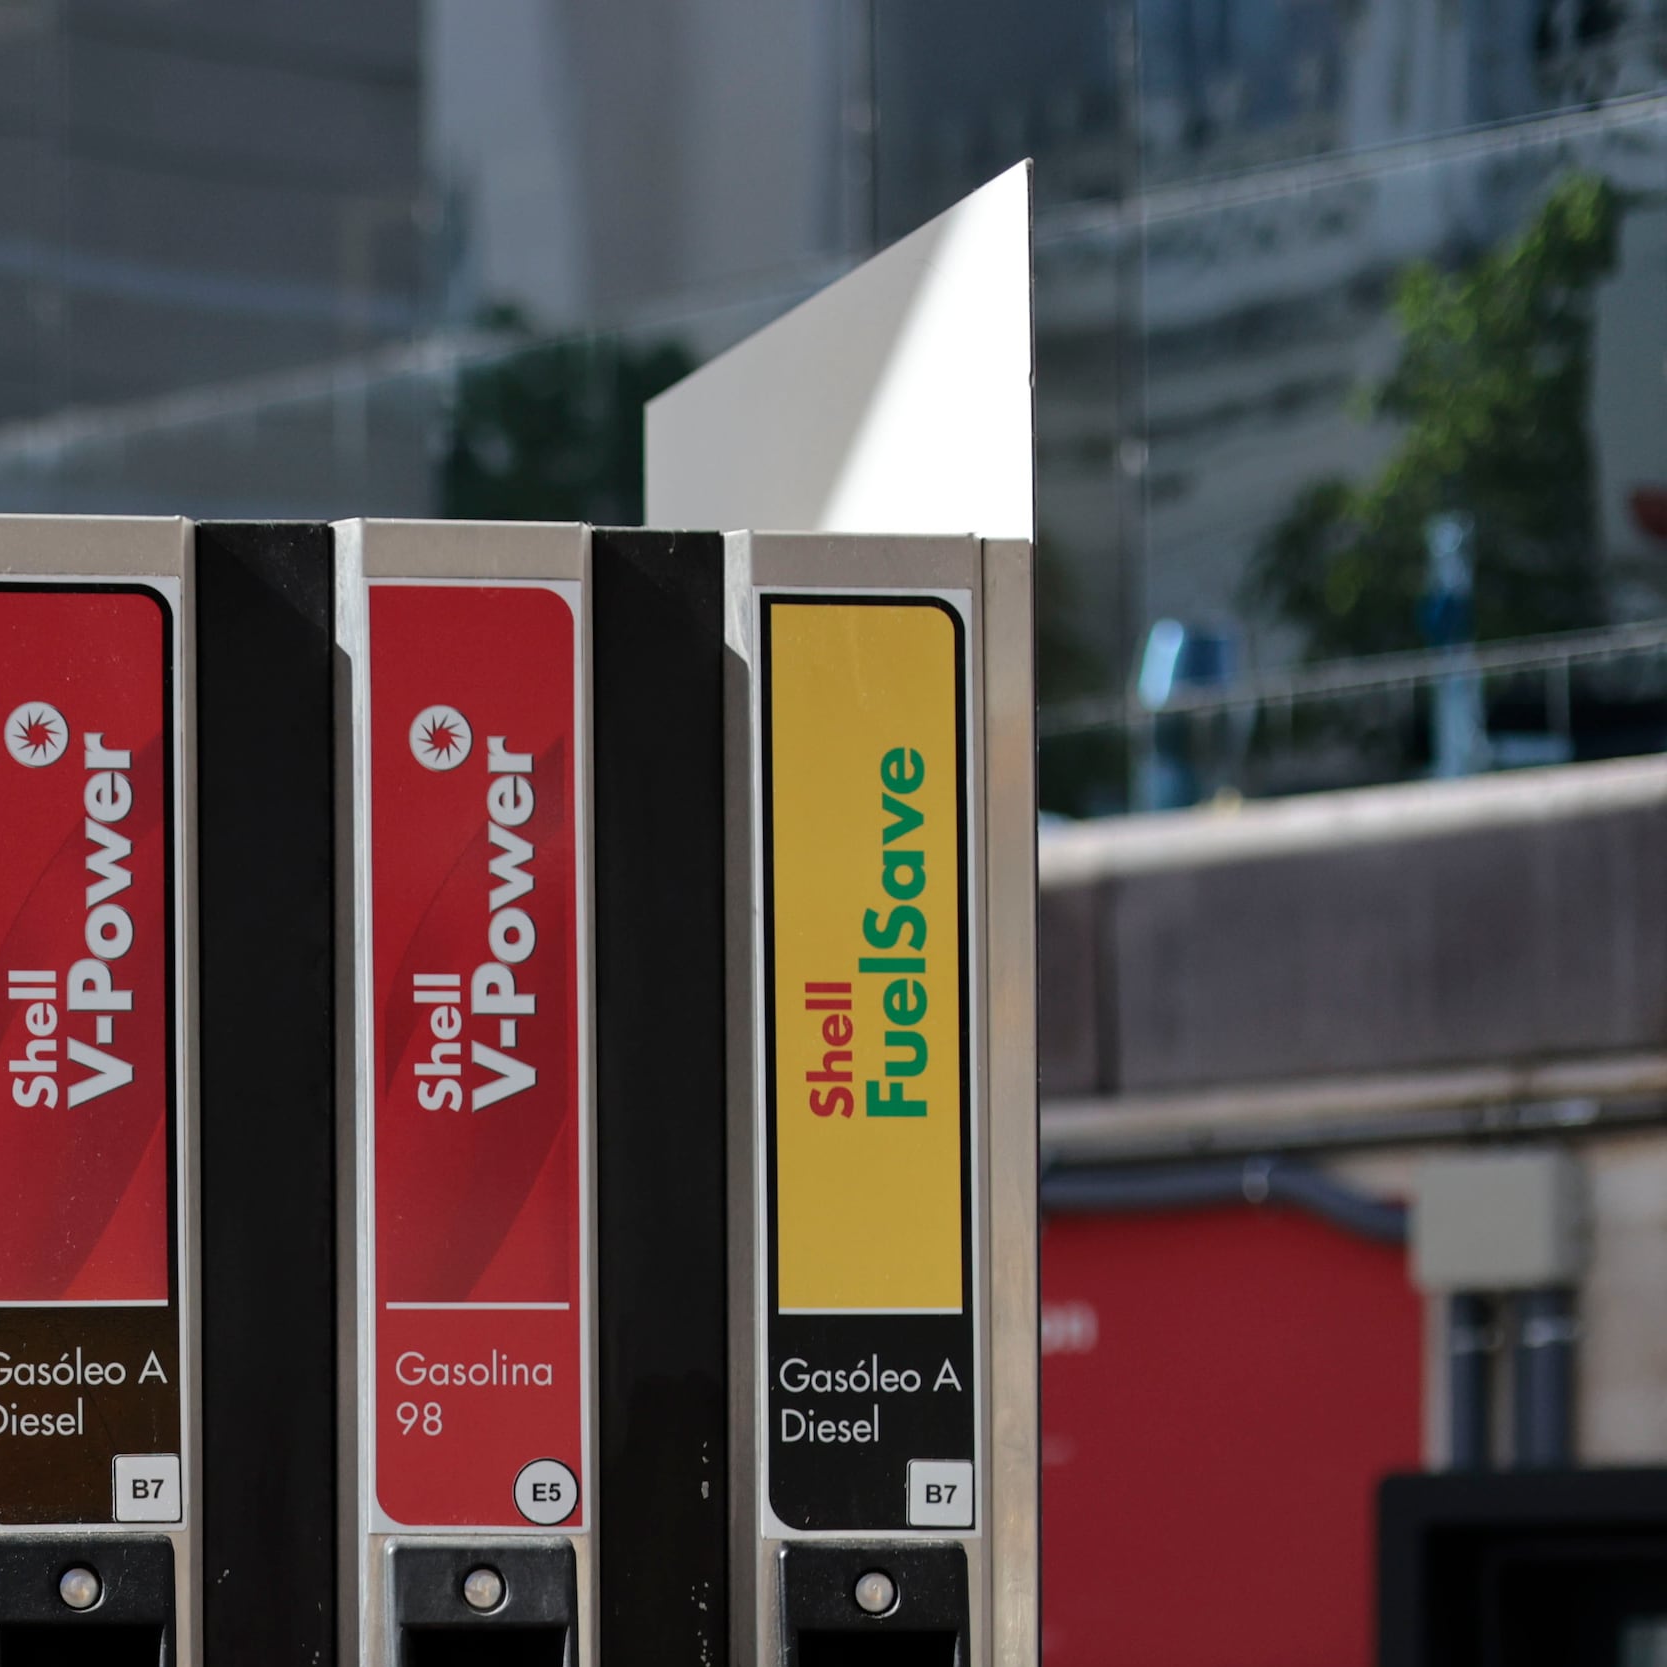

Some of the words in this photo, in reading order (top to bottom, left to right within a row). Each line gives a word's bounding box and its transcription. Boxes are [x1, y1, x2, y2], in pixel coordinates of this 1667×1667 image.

[67, 732, 135, 1111] V-Power
[470, 735, 538, 1113] V-Power
[858, 746, 929, 1119] FuelSave
[8, 969, 58, 1110] Shell
[413, 973, 462, 1113] Shell
[805, 981, 854, 1120] Shell
[138, 1350, 168, 1385] A
[395, 1348, 553, 1387] Gasolina
[779, 1354, 922, 1394] Gasóleo
[933, 1359, 963, 1392] A
[396, 1400, 443, 1437] 98
[780, 1404, 880, 1443] Diesel
[132, 1478, 165, 1500] B7
[532, 1482, 562, 1503] E5
[925, 1483, 957, 1504] B7
